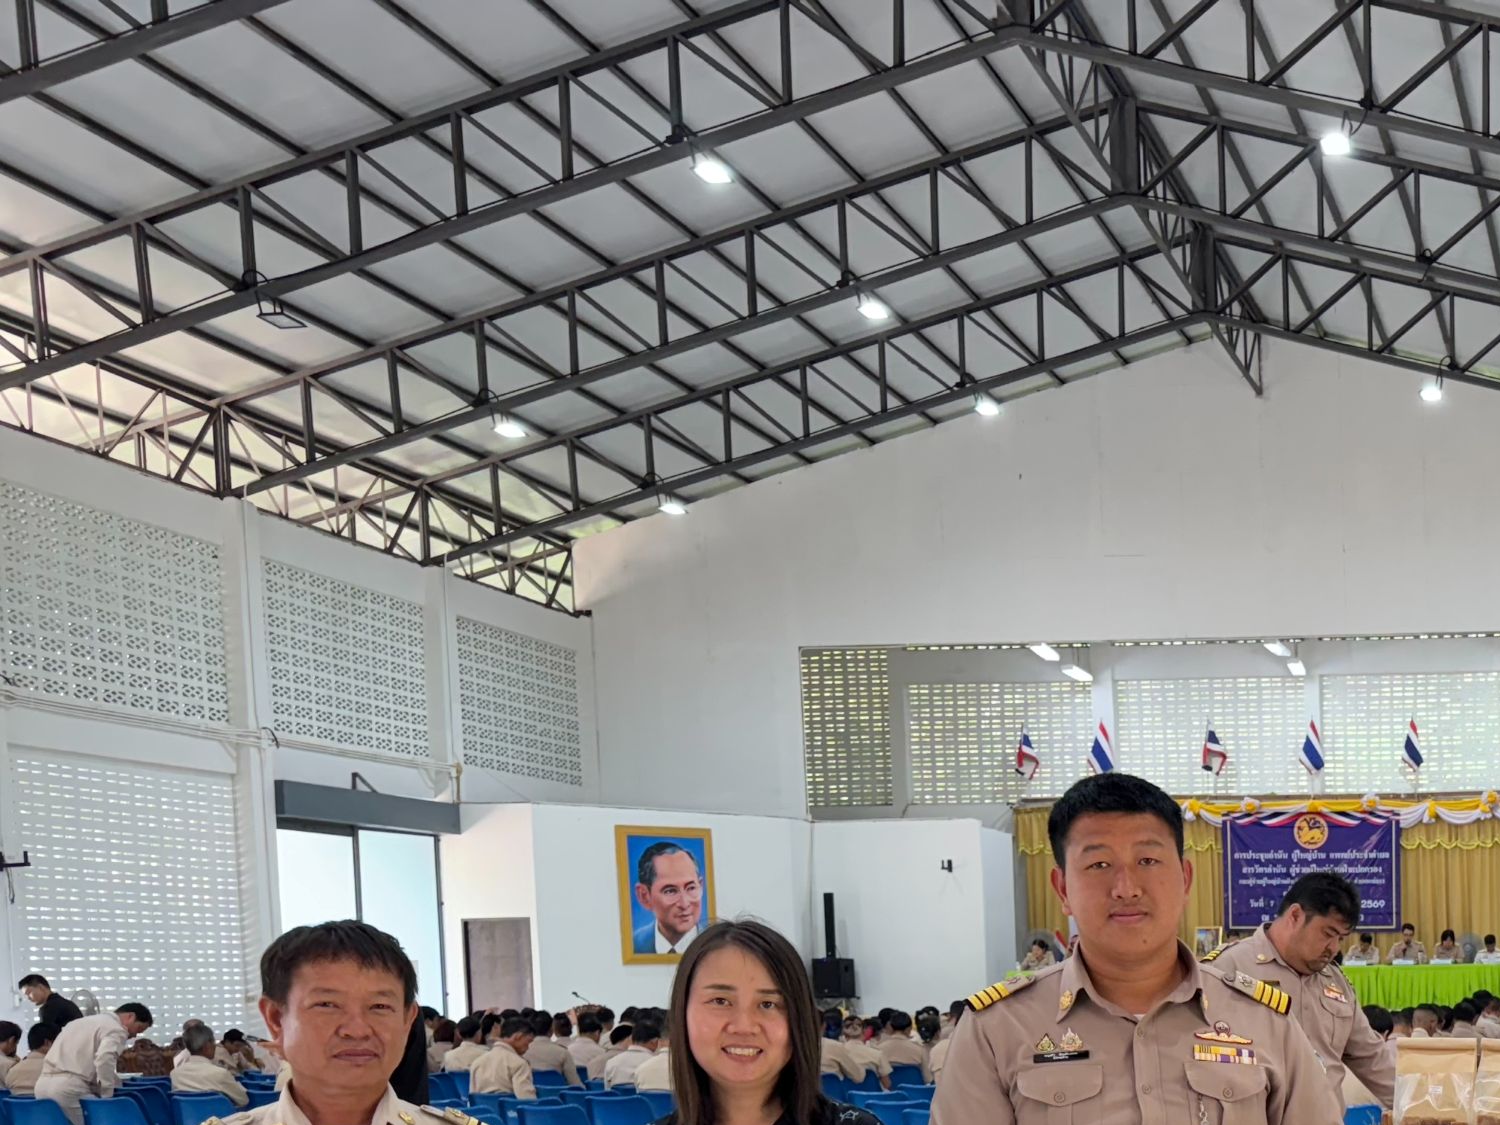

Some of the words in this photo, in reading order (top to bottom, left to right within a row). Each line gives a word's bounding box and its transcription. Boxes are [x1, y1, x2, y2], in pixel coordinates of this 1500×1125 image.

[1291, 850, 1326, 862] ผู้ใหญ่บ้าน
[1361, 899, 1385, 908] 2569
